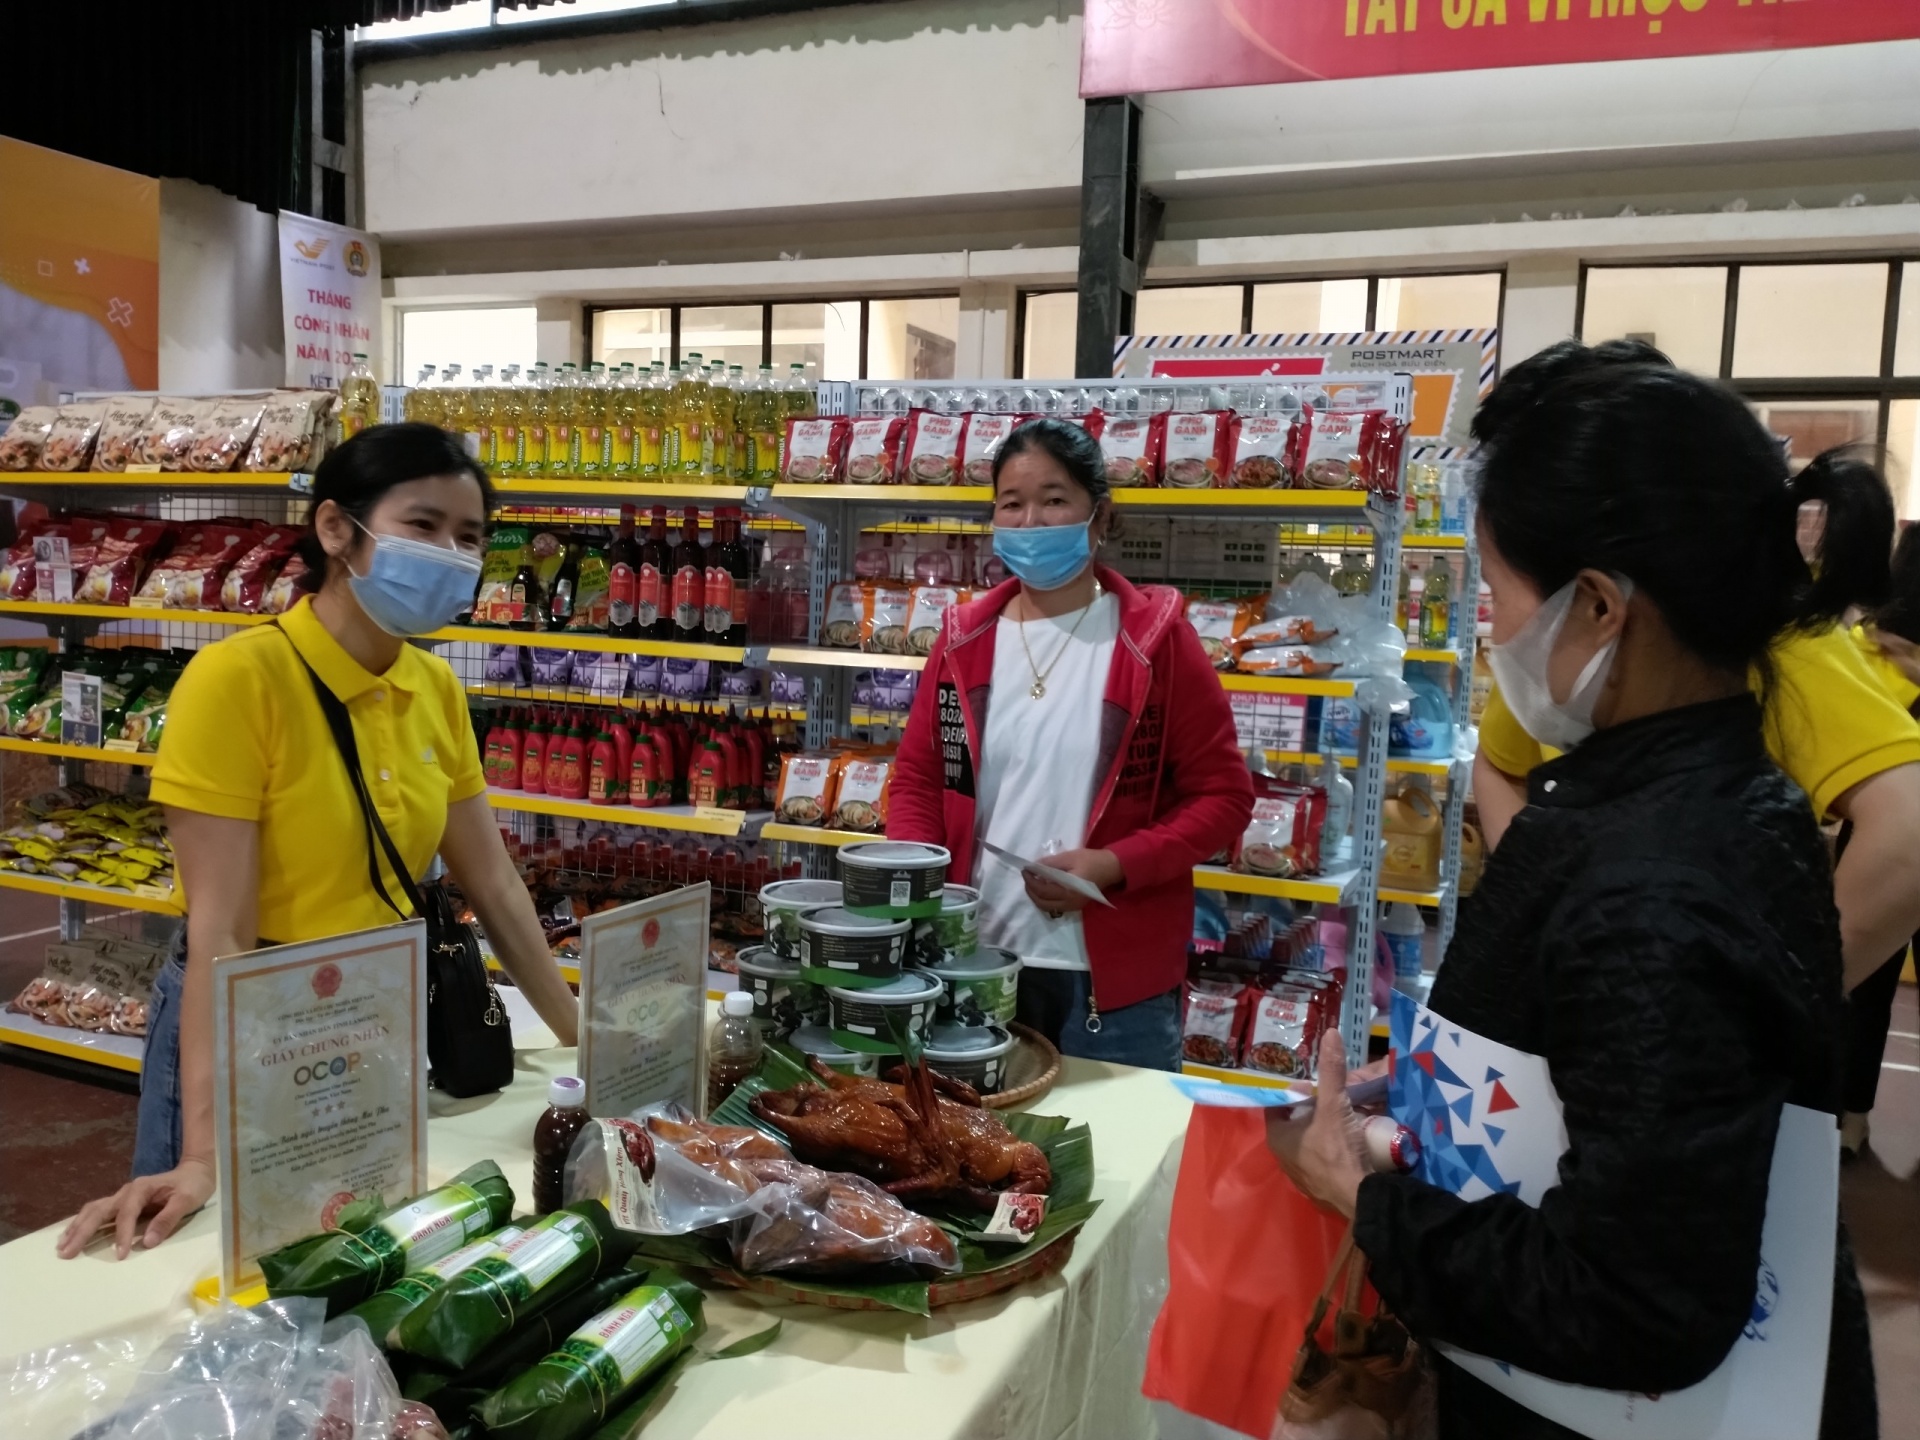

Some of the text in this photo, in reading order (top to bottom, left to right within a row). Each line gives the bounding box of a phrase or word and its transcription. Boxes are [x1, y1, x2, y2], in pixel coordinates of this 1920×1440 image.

[307, 287, 352, 310] THÁNG
[294, 313, 370, 341] CÔNG NHÂN
[296, 343, 330, 362] NĂM
[1352, 349, 1445, 360] POSTMART
[310, 370, 333, 388] KẾT
[294, 1052, 361, 1086] OCOP
